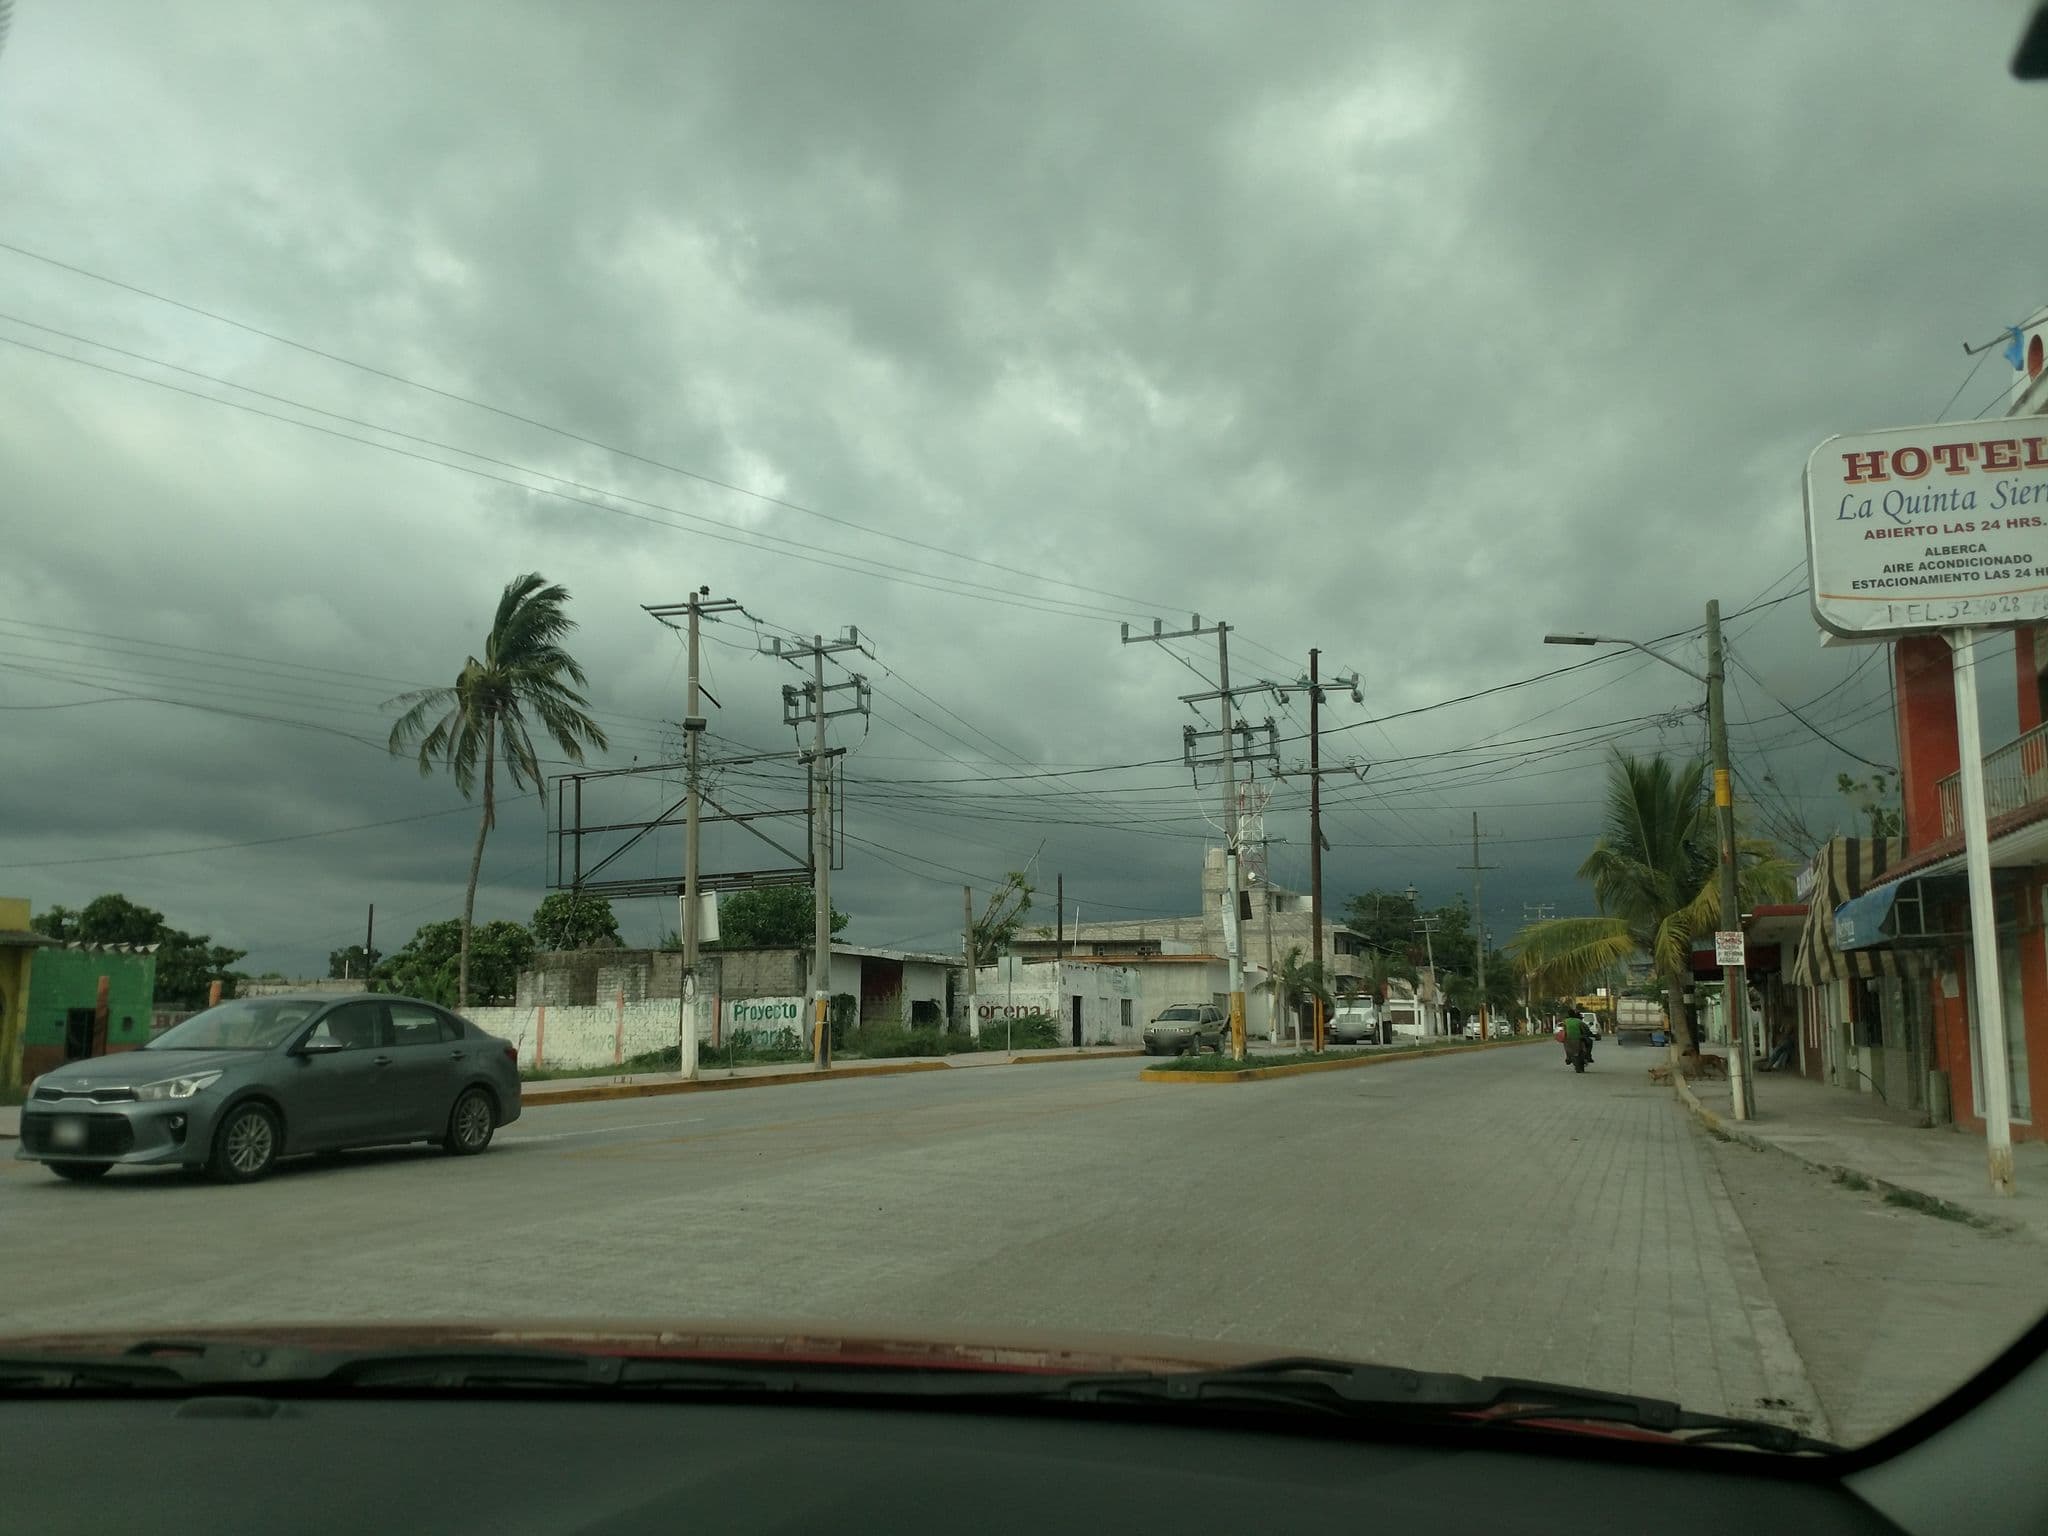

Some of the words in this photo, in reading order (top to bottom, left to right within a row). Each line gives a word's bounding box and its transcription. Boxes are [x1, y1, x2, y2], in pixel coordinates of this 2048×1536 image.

[1842, 437, 2048, 484] HOTEL
[1836, 494, 1872, 520] La
[1883, 486, 1977, 525] Quinta
[1864, 525, 1938, 540] ABIERTO
[1944, 522, 1975, 534] LAS
[1981, 520, 2001, 531] 24
[2006, 517, 2048, 529] HRS.
[1925, 543, 1987, 557] ALBERCA
[1883, 562, 1914, 574] AIRE
[1918, 554, 2033, 571] ACONDICIONADO
[1852, 571, 1980, 590] ESTACIONAMIENTO
[1984, 569, 2011, 580] LAS
[2015, 568, 2031, 578] 24
[734, 1003, 797, 1021] Proyecto
